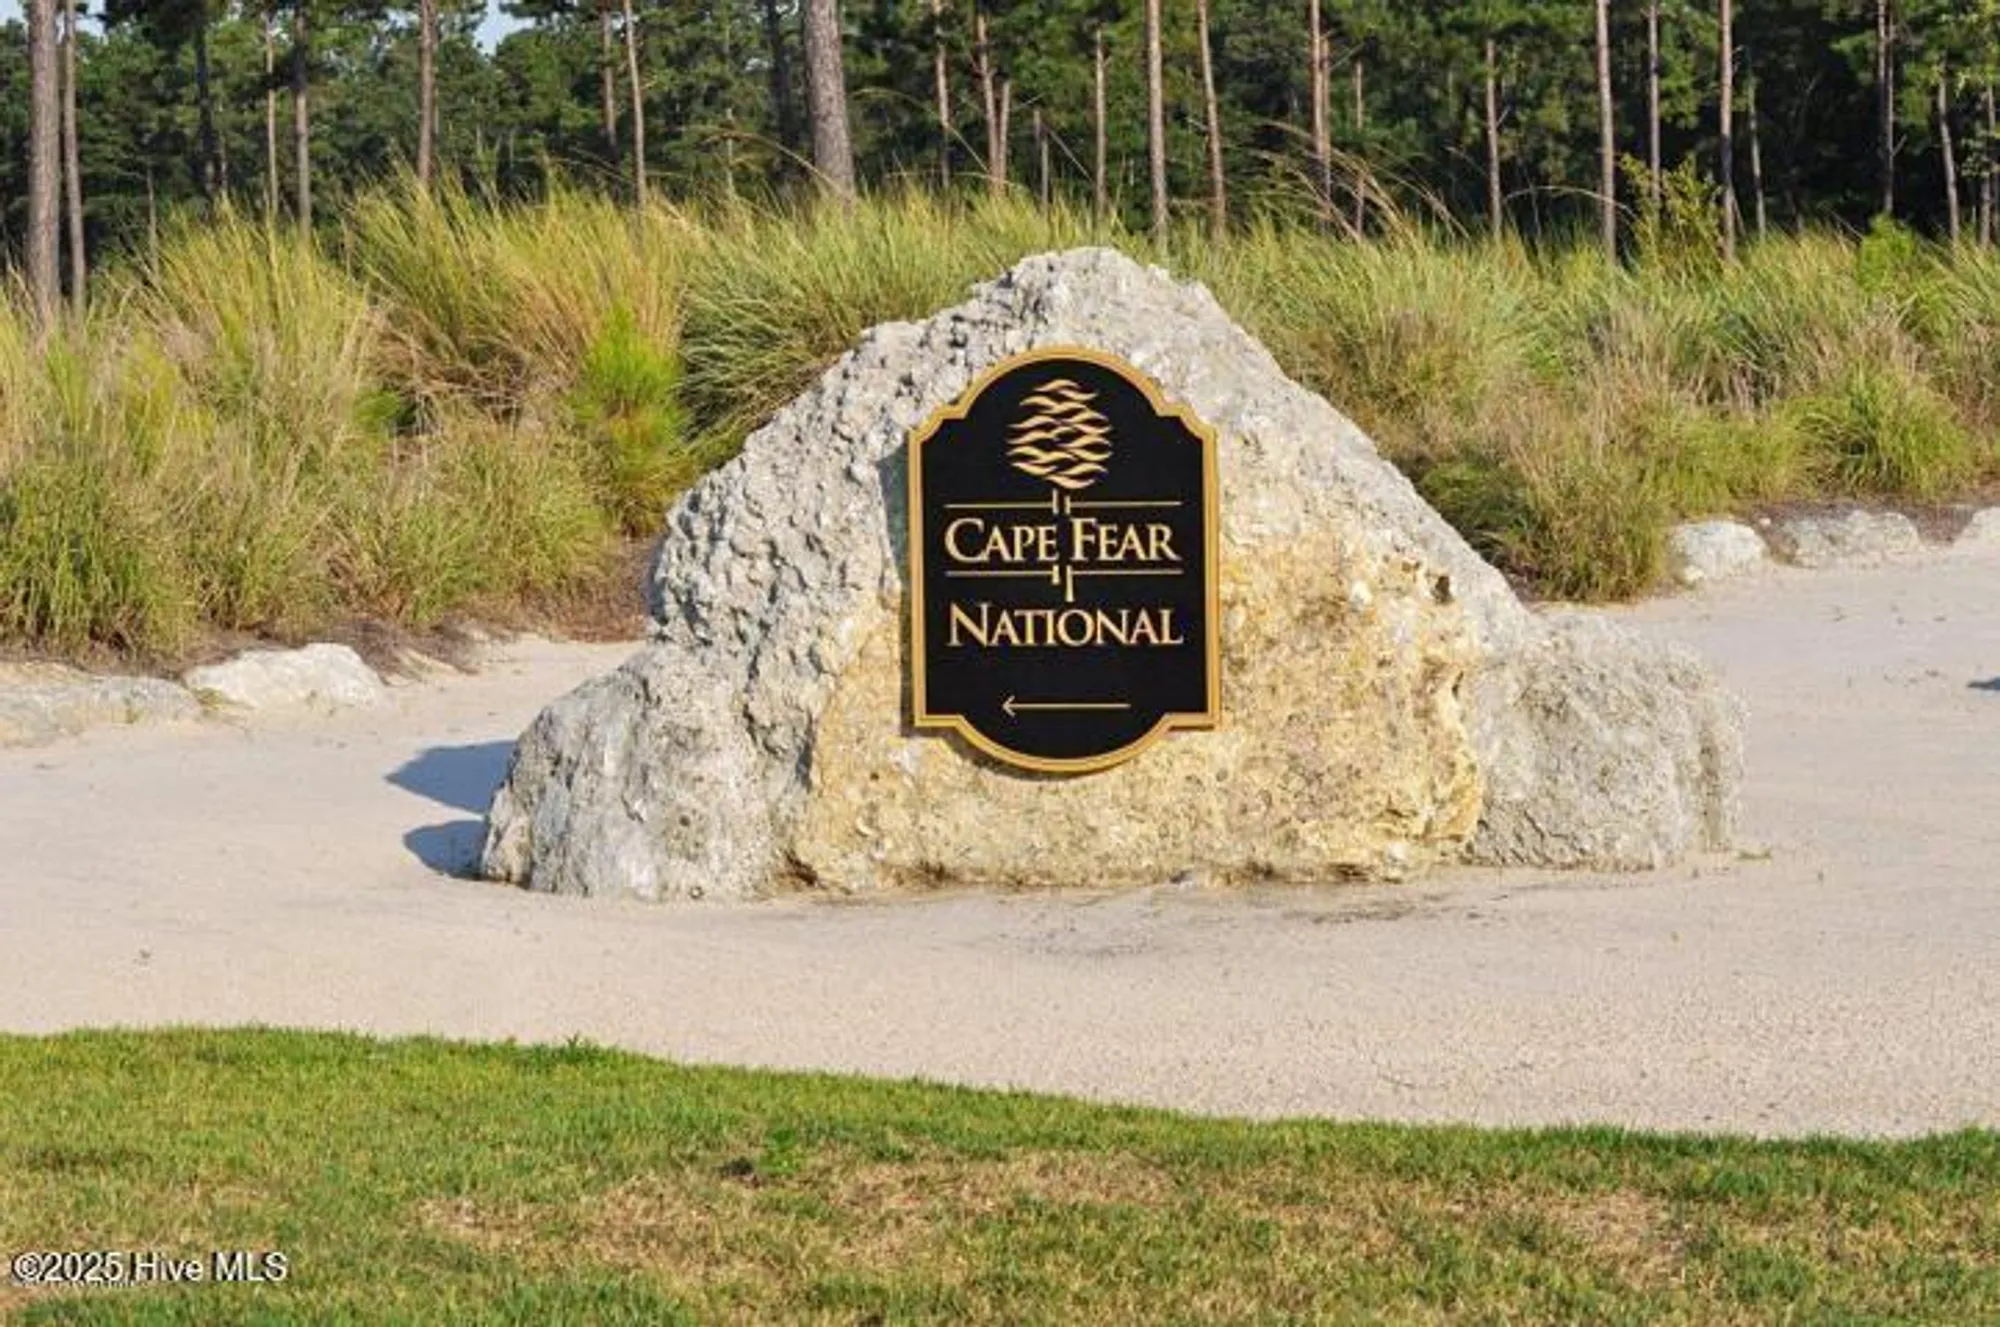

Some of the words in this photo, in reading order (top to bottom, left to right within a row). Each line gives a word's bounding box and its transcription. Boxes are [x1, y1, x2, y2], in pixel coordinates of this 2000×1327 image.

[944, 517, 1060, 563] CAPE
[1069, 516, 1180, 562] FEAR
[948, 603, 1184, 648] NATIONAL
